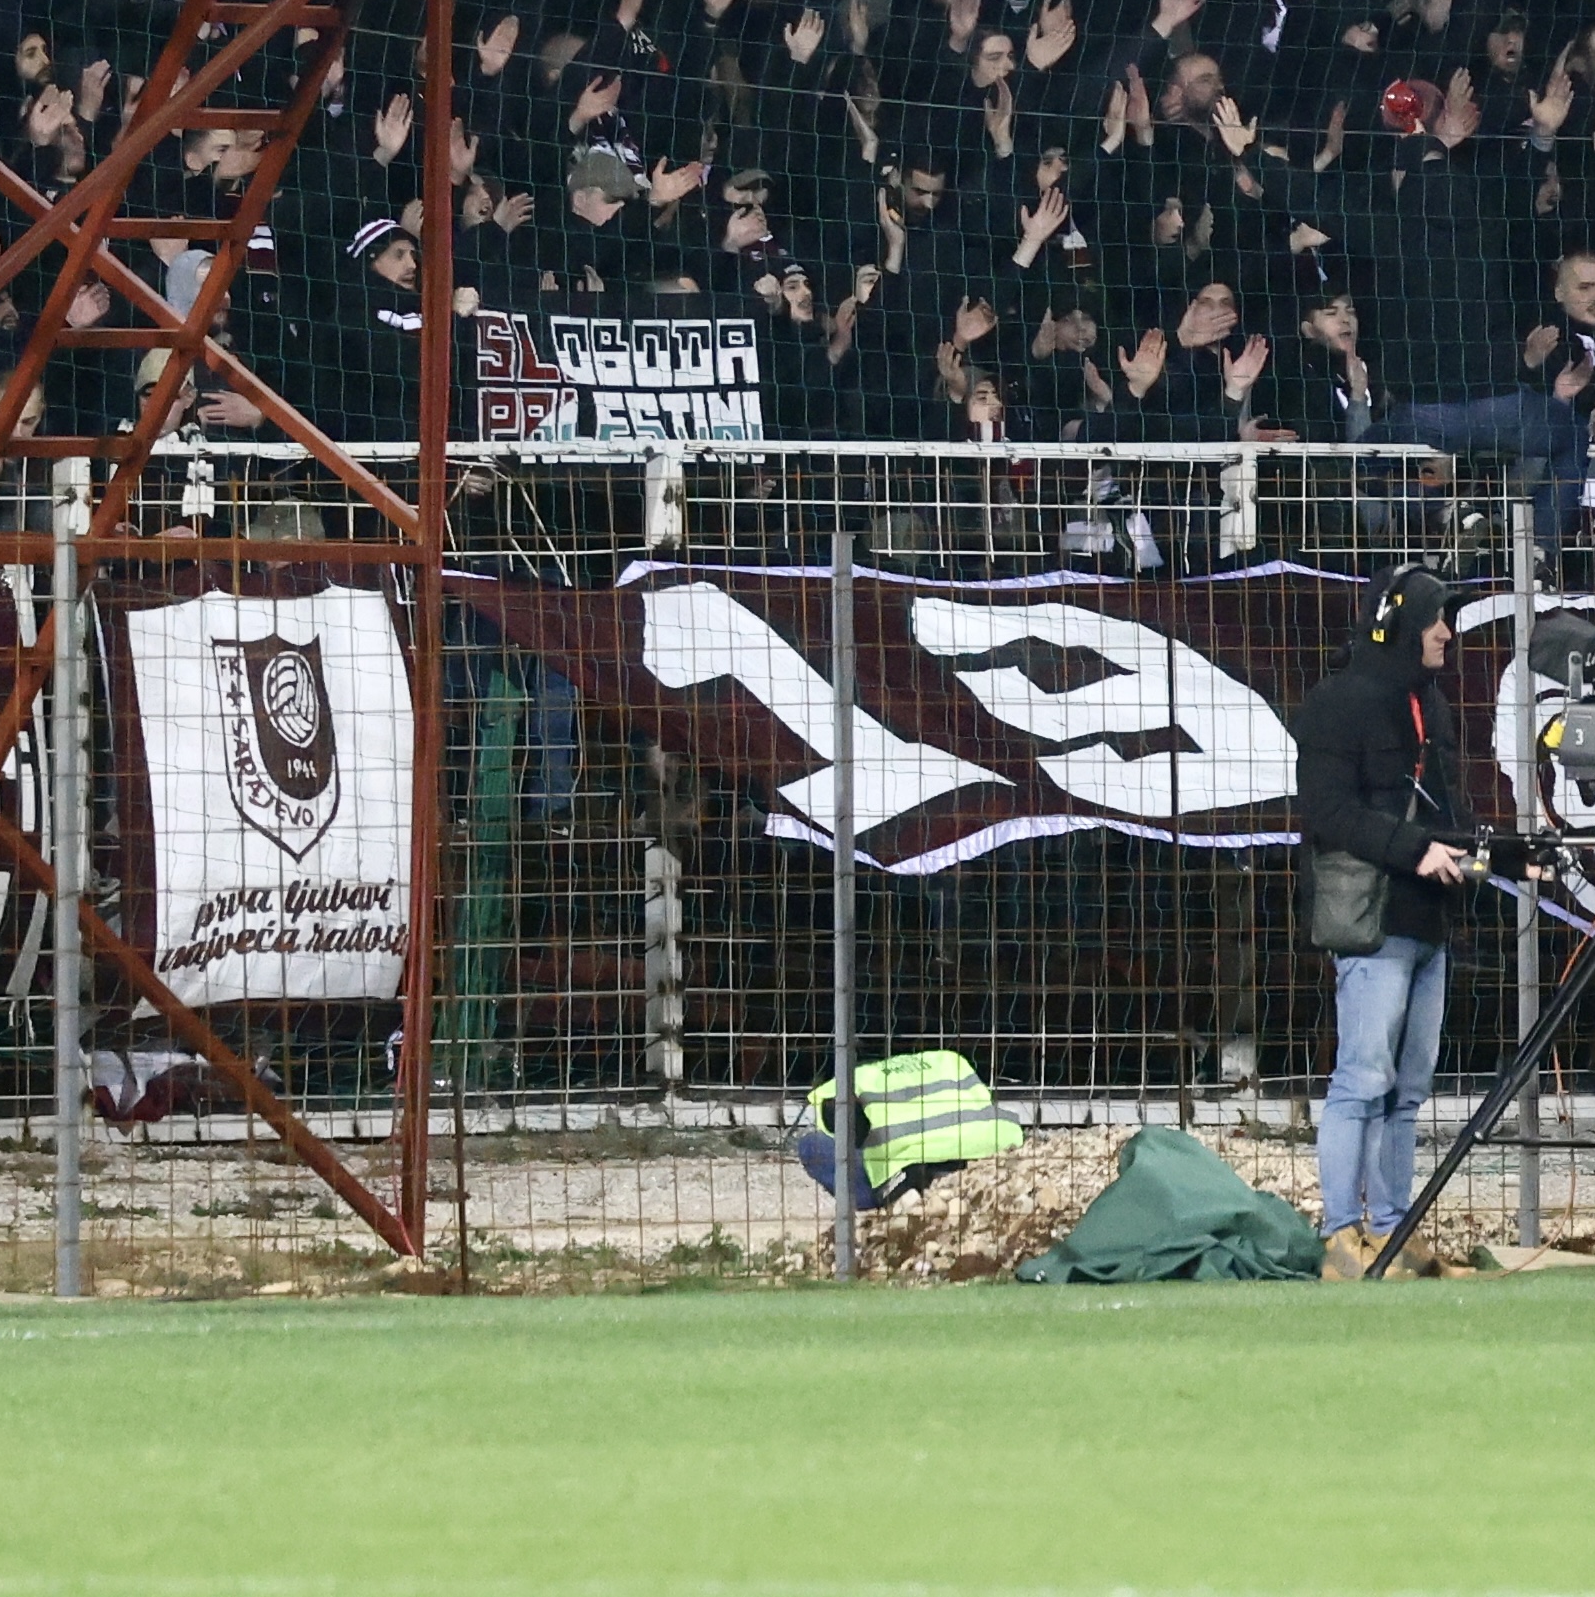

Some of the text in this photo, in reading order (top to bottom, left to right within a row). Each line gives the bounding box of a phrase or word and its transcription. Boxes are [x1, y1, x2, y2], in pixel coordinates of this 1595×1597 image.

[475, 309, 761, 388] SLOBODA
[477, 387, 765, 464] PALESTINI
[1574, 728, 1585, 746] 3
